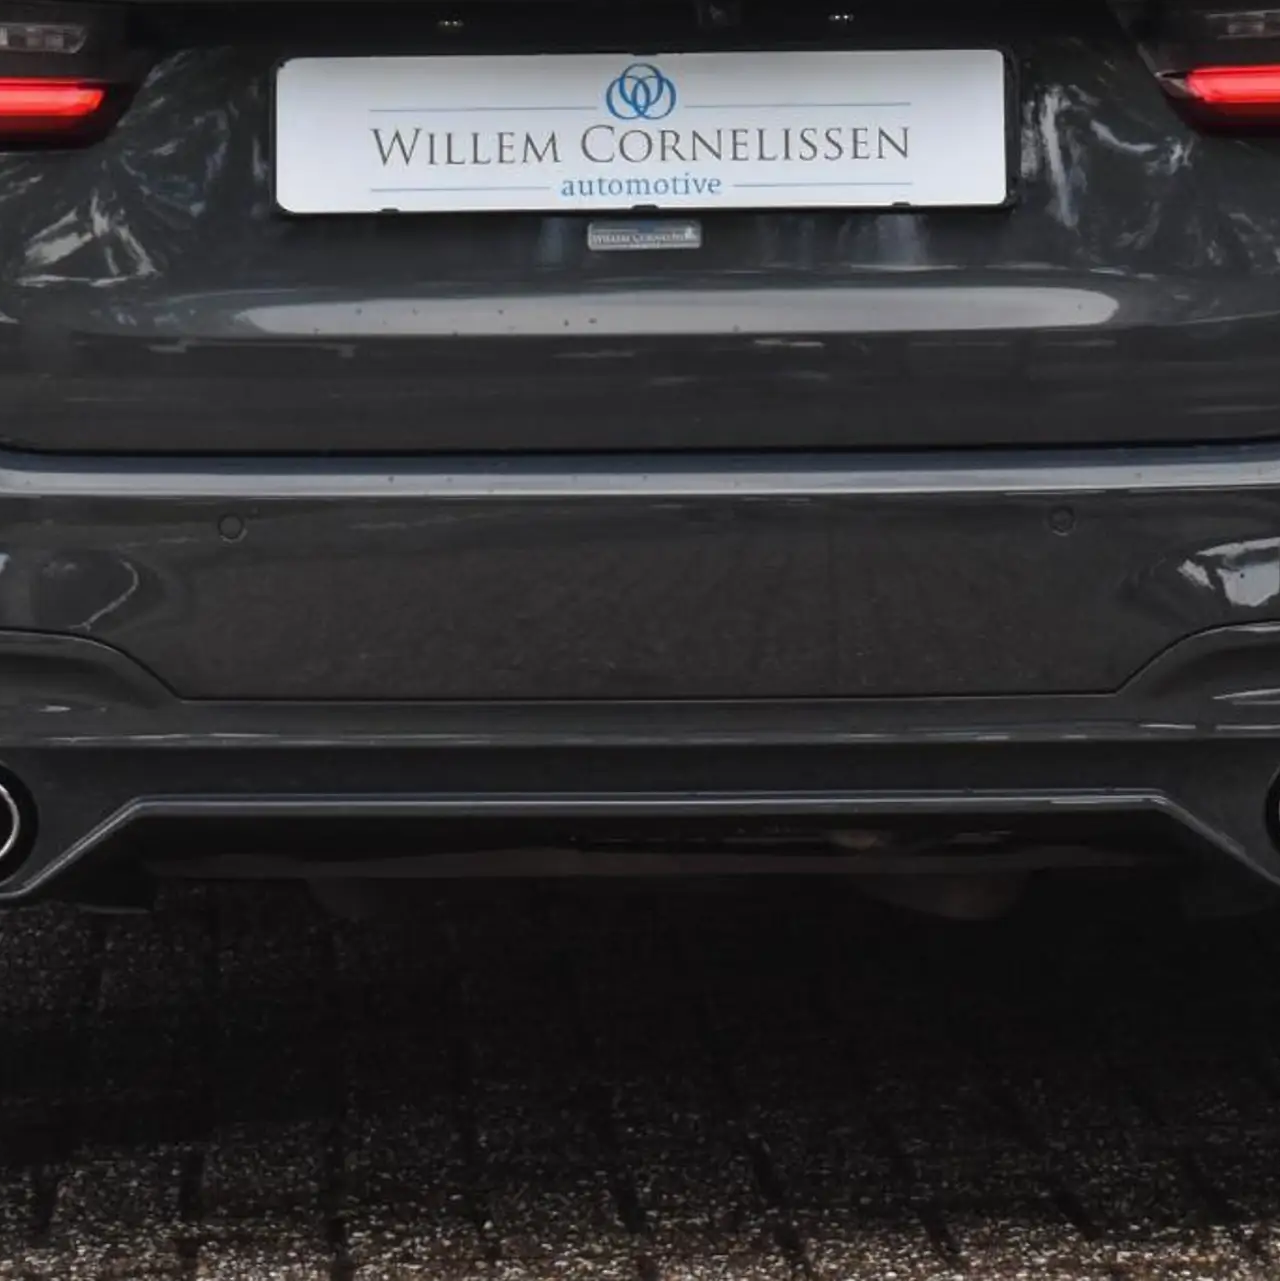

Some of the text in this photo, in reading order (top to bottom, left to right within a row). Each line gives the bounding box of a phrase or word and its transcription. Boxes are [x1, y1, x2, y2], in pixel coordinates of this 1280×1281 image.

[370, 123, 911, 167] WILLEM CORNELISSEN
[560, 172, 722, 197] automotive
